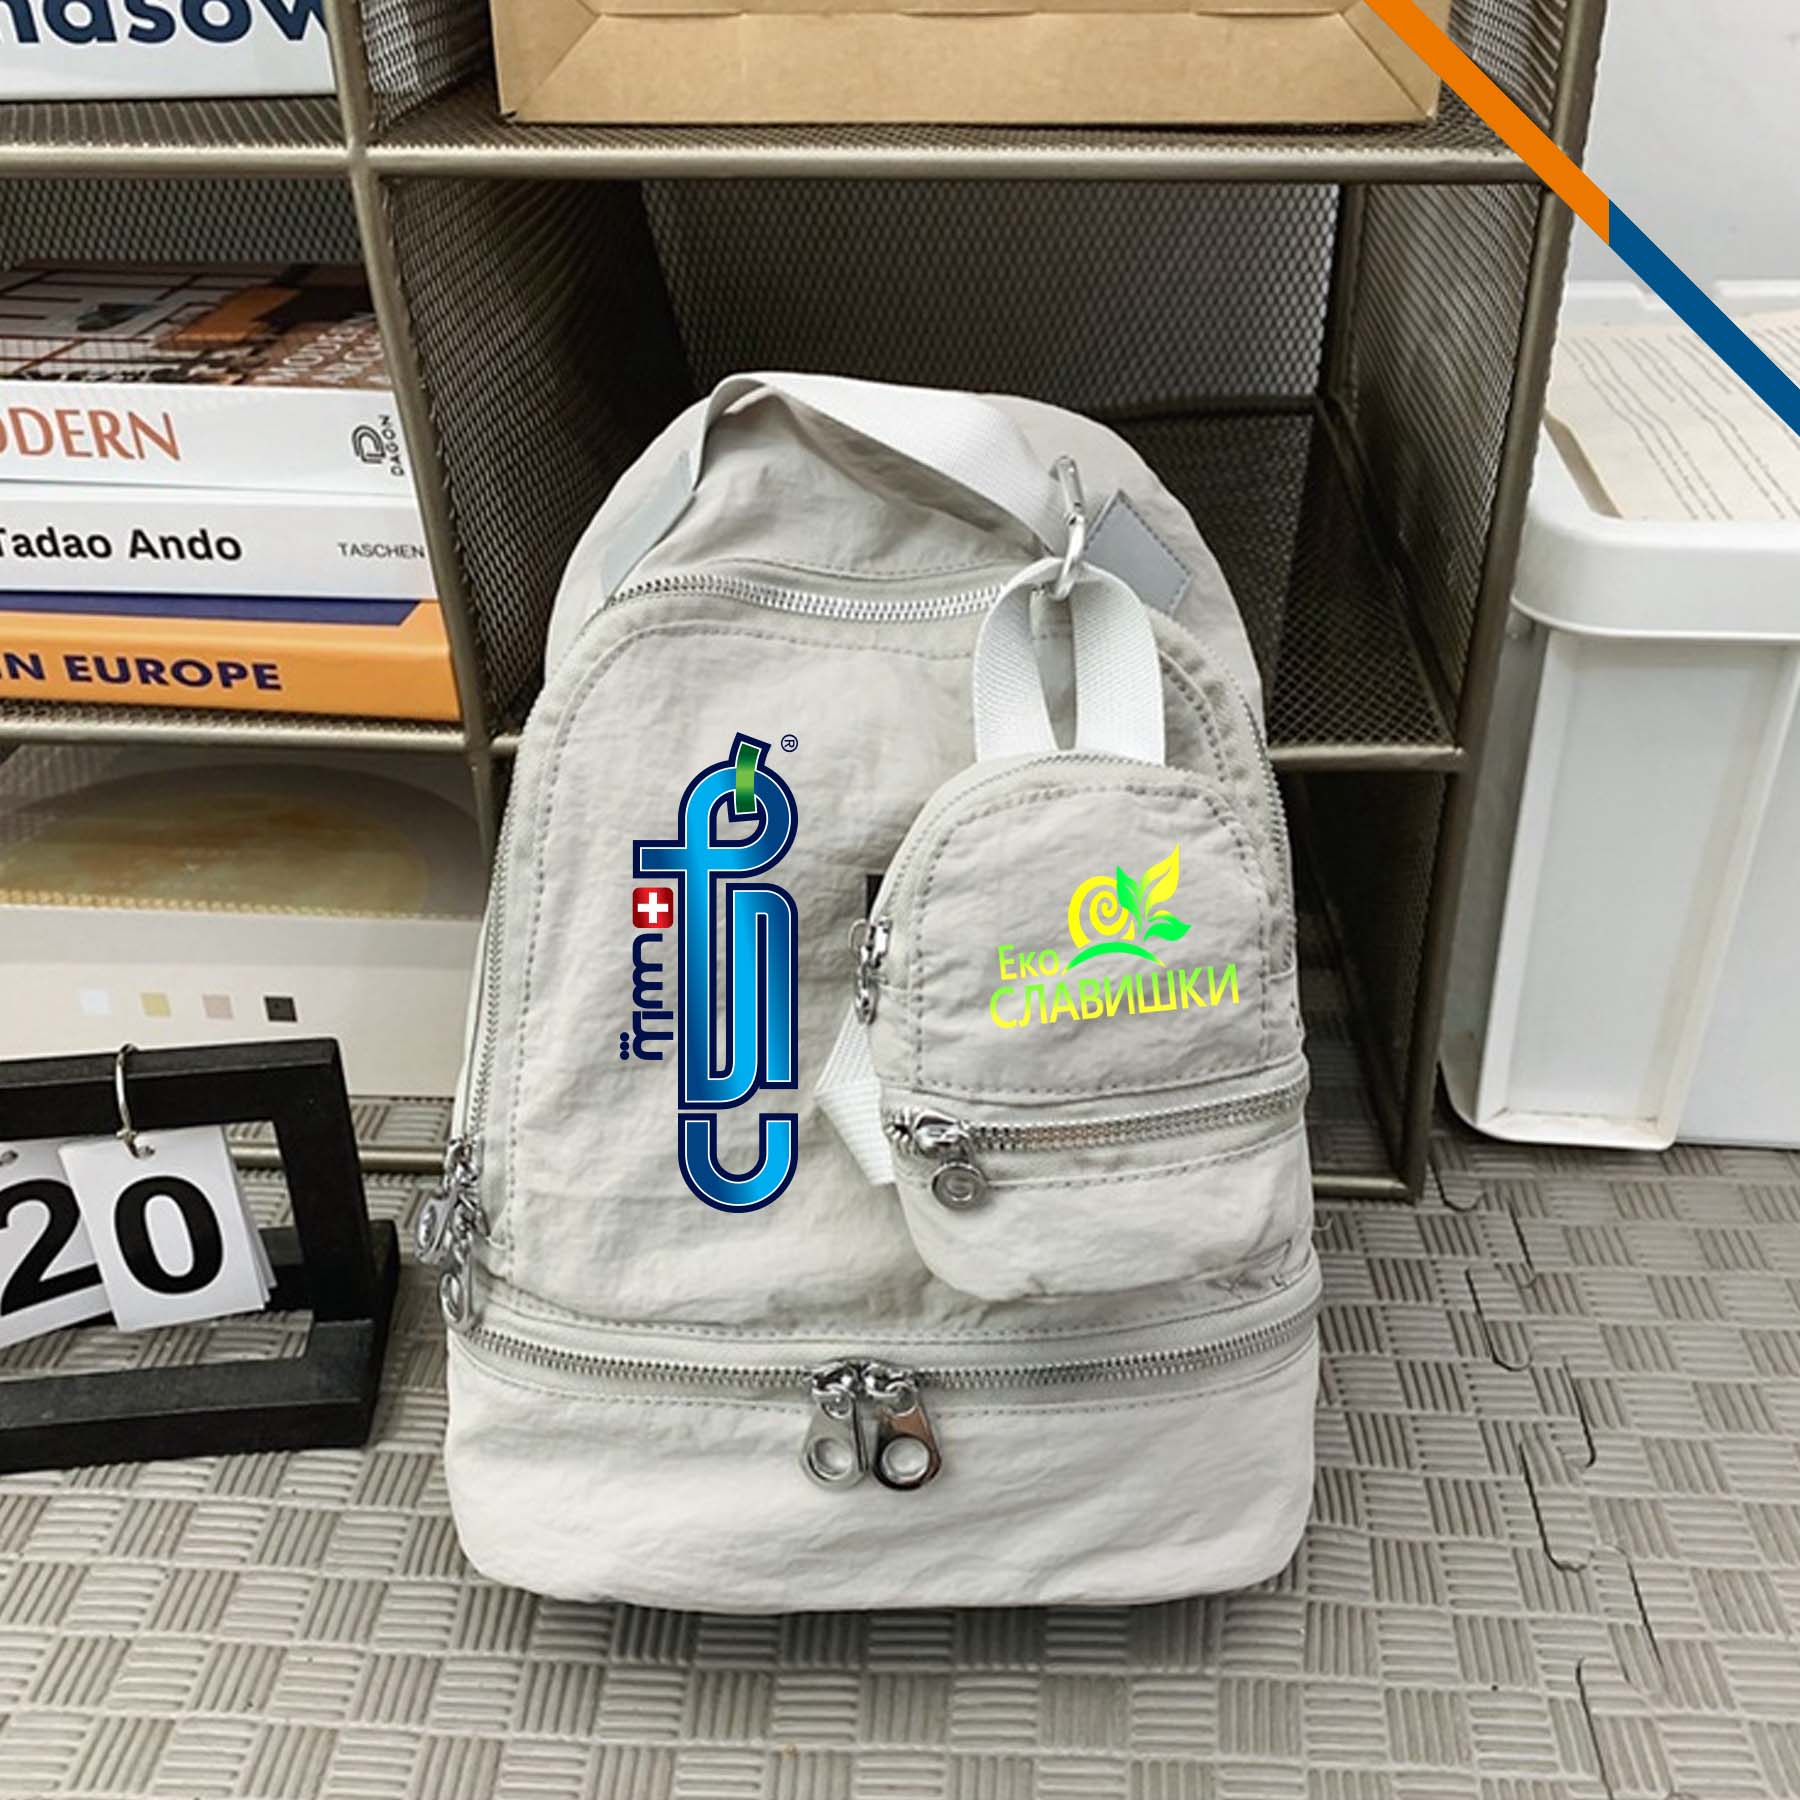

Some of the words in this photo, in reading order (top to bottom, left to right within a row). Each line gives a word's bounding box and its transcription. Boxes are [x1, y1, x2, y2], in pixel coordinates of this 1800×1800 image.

[0, 407, 180, 460] DERN
[128, 530, 243, 561] Ando
[338, 542, 425, 559] TASCHEN
[63, 654, 282, 690] EUROPE
[989, 963, 1240, 1029] СЛАВИШКИ
